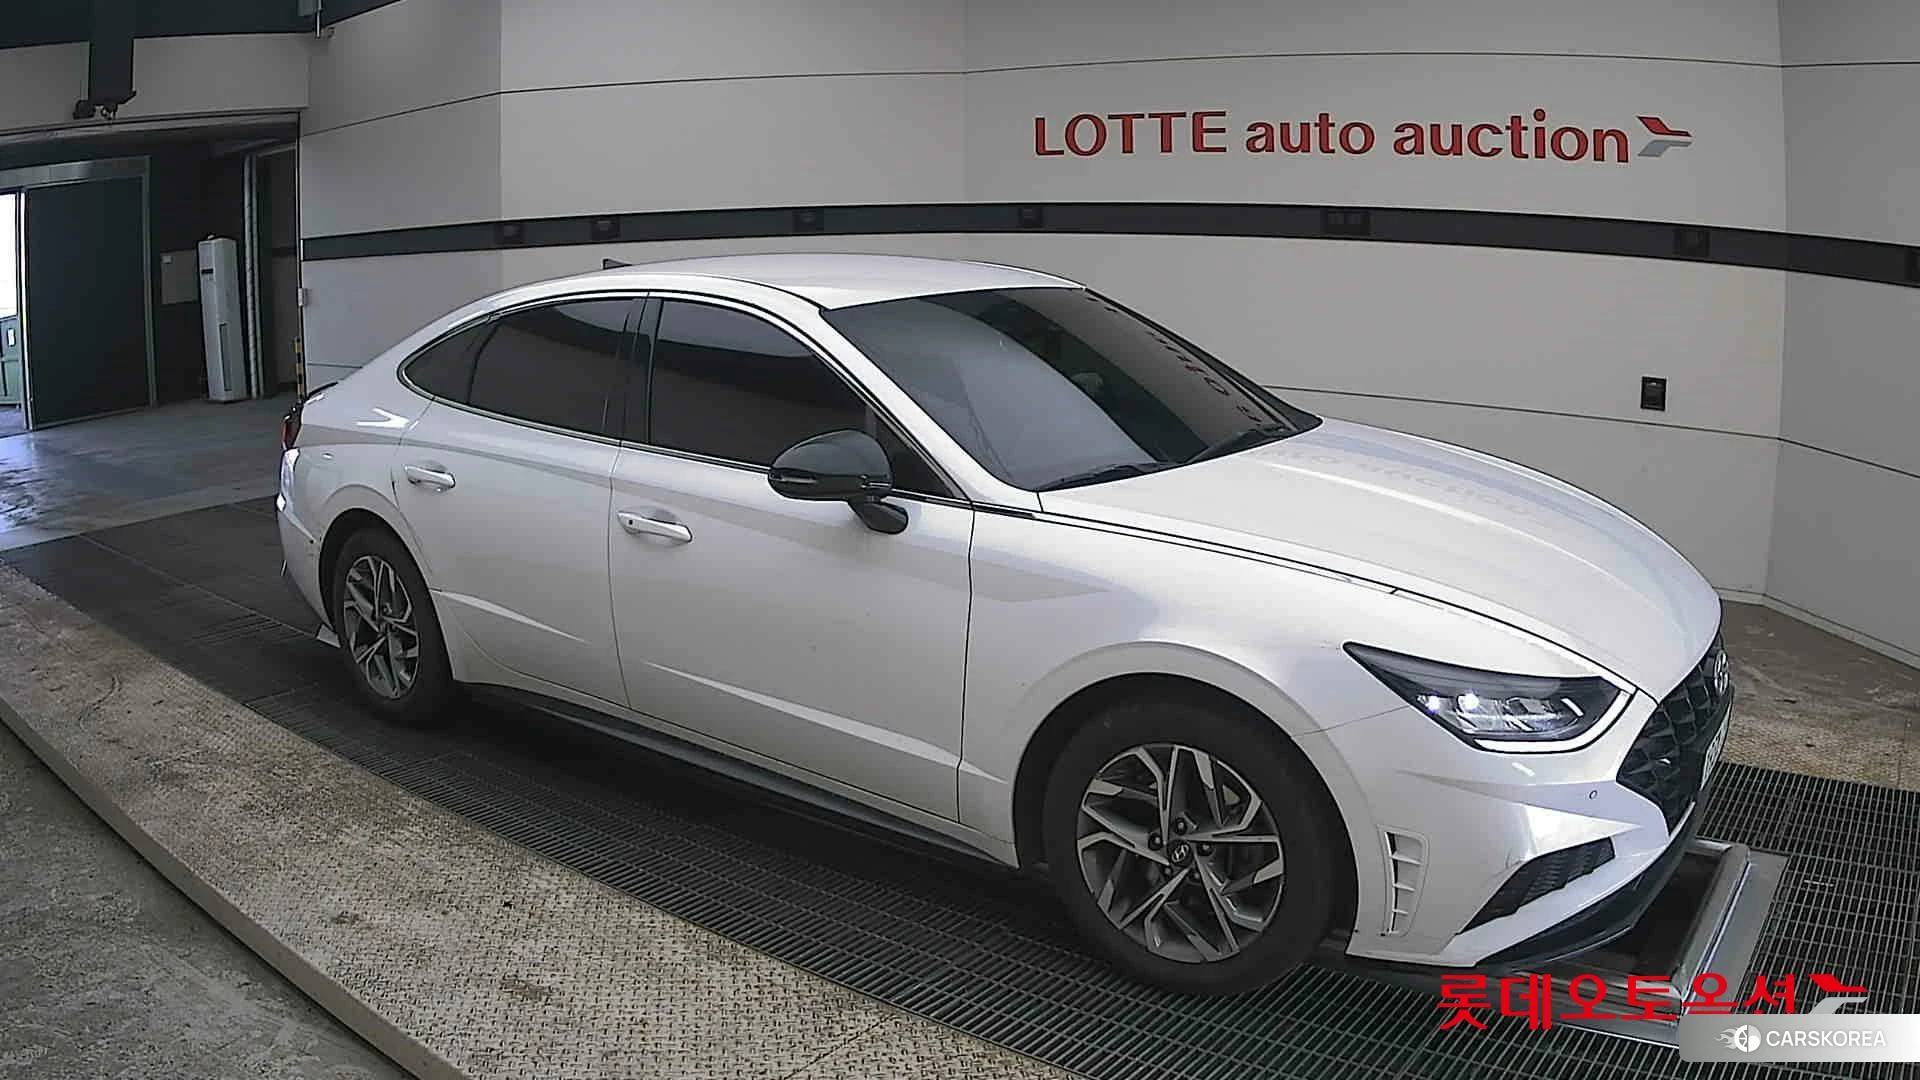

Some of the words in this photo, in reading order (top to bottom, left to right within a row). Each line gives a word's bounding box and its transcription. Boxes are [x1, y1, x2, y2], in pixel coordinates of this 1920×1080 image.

[1034, 111, 1228, 156] LOTTE
[1245, 112, 1376, 154] auto
[1393, 109, 1630, 163] auction
